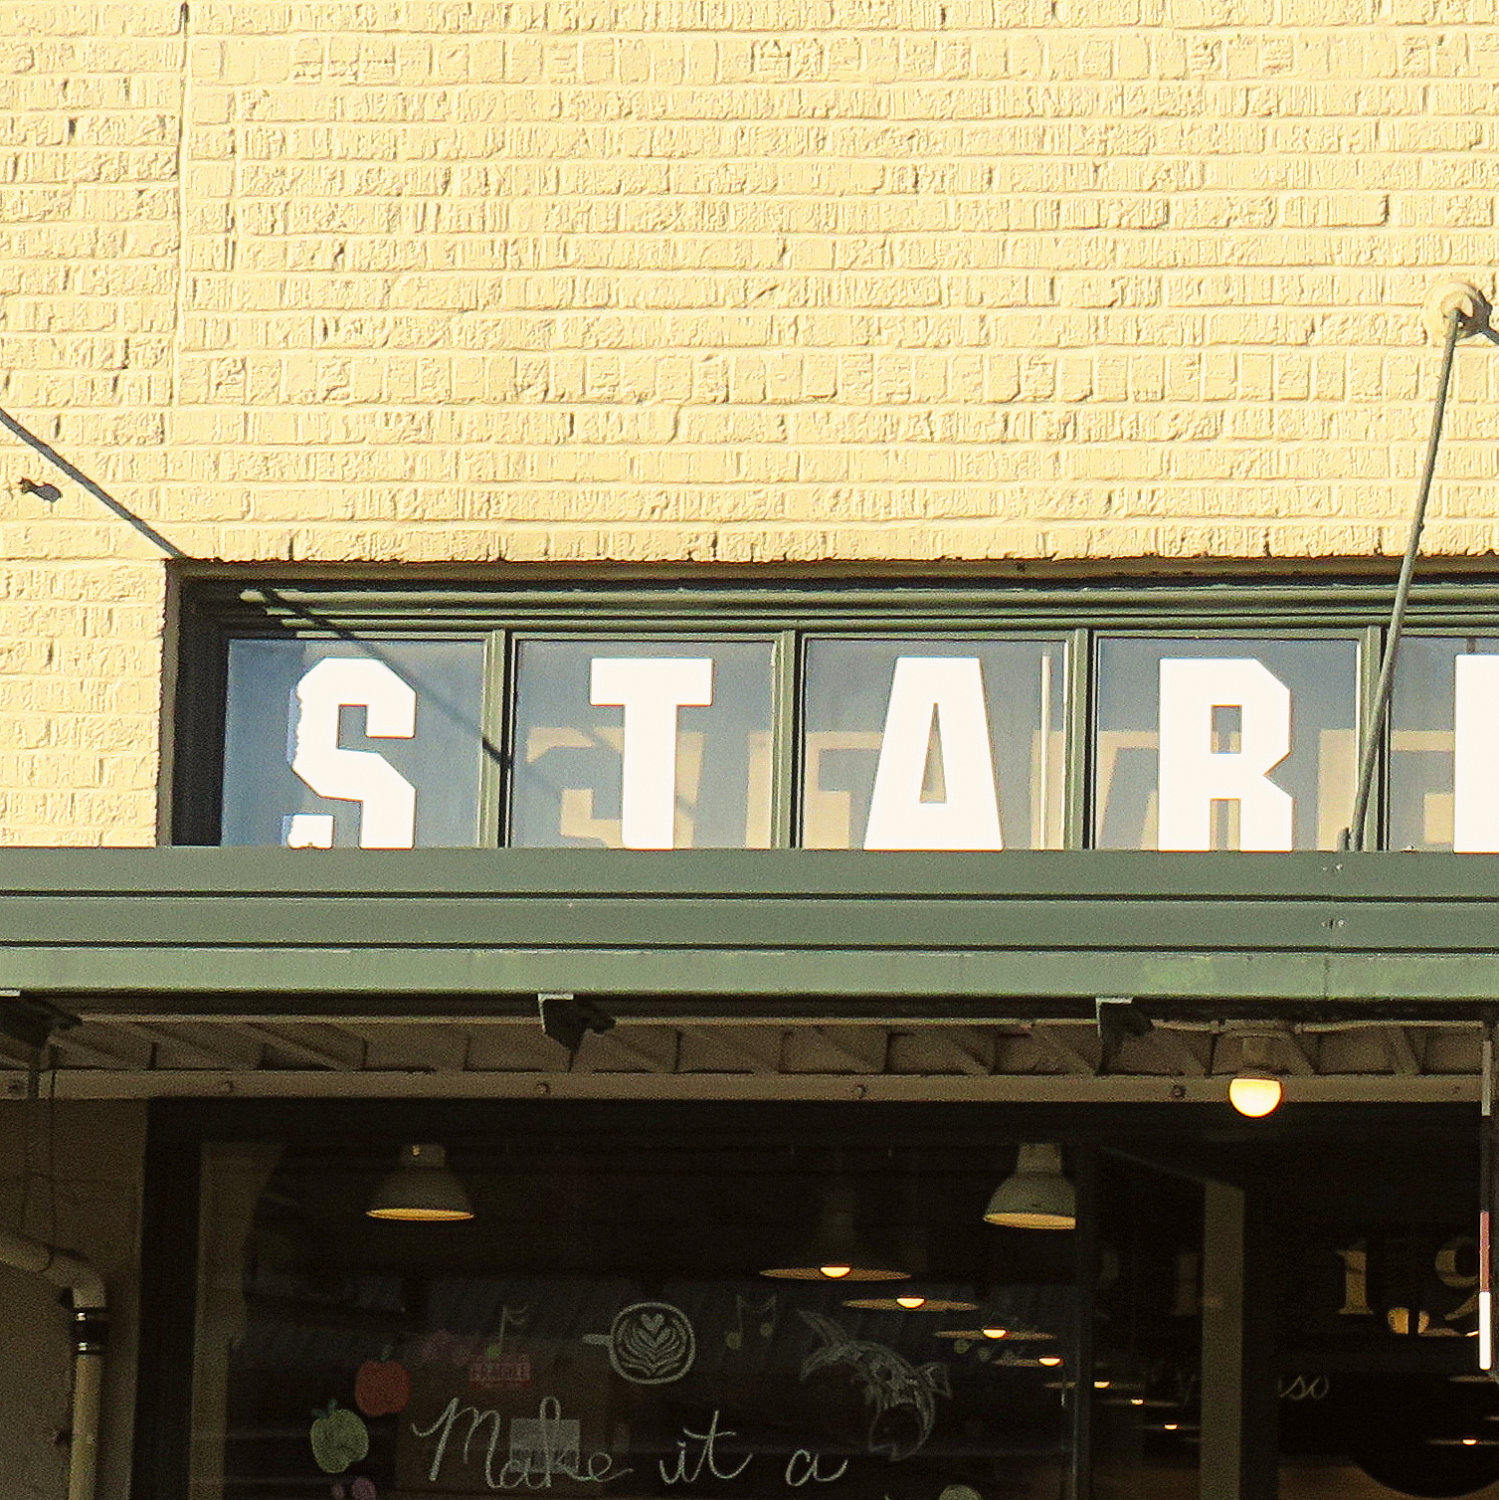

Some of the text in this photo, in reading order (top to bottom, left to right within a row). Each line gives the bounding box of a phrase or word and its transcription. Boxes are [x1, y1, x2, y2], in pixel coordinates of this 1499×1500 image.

[413, 1396, 850, 1490] Make it a
